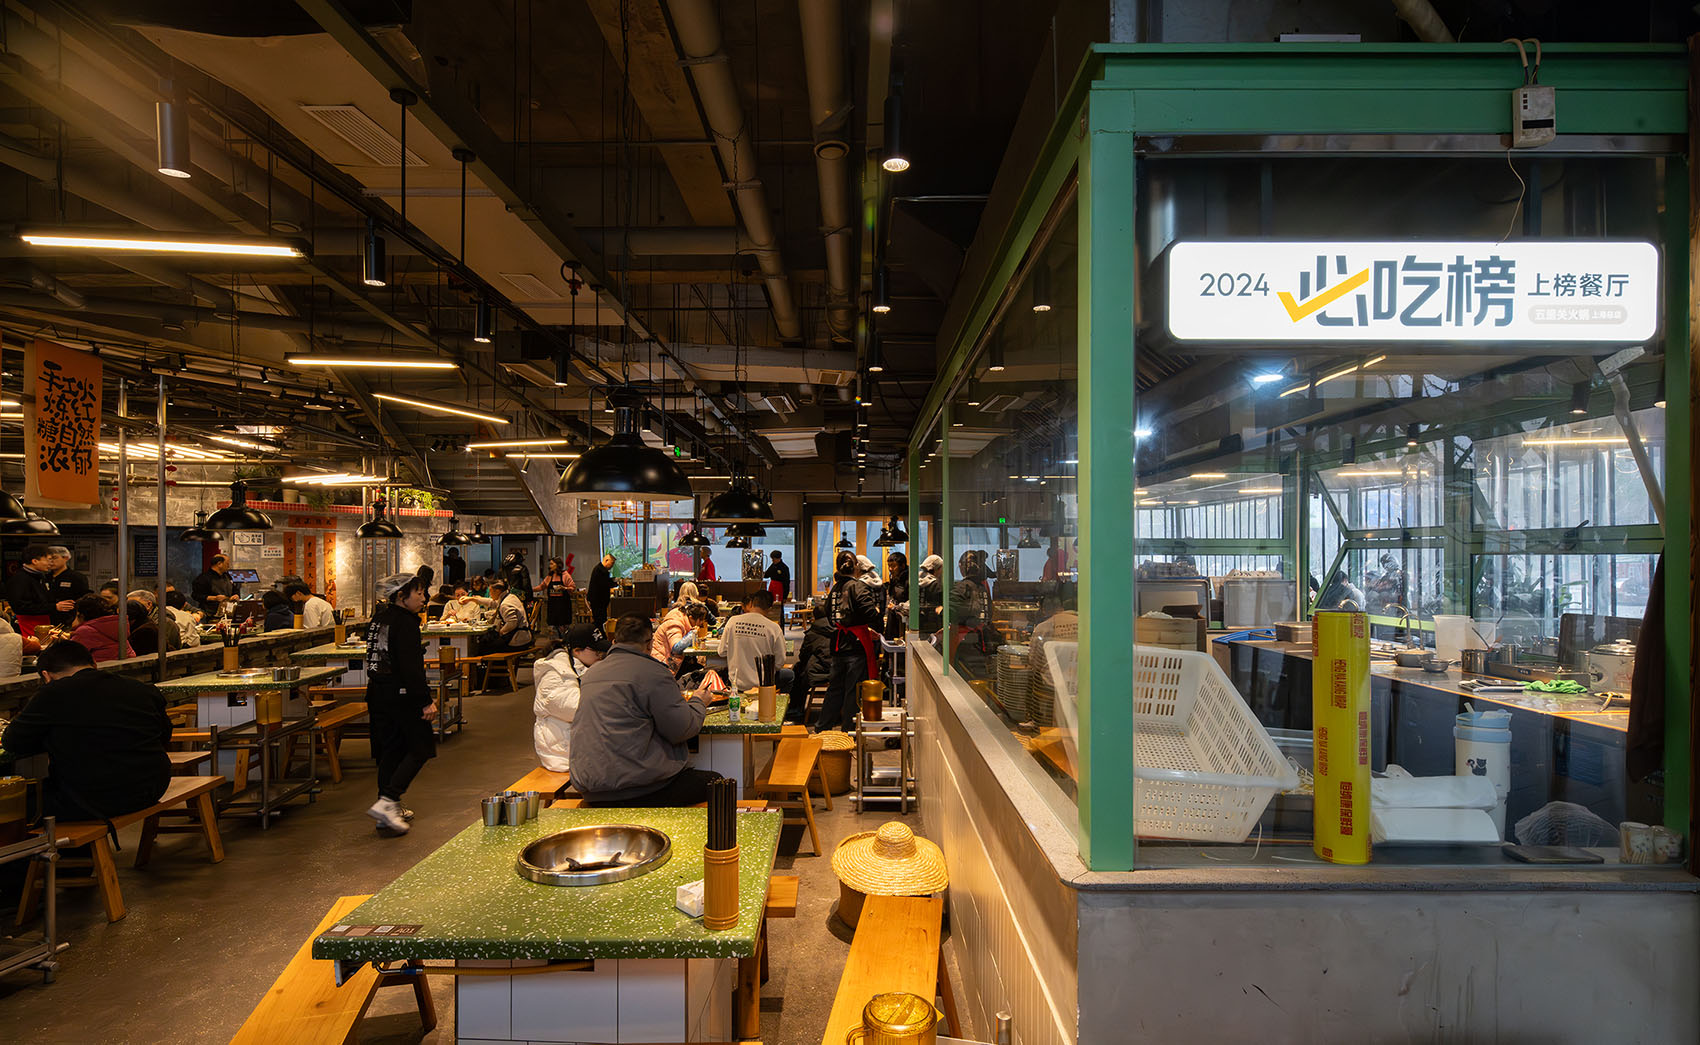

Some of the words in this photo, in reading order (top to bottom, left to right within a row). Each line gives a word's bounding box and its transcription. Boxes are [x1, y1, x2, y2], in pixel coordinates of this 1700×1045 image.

[1200, 273, 1270, 297] 2024
[1277, 255, 1516, 327] 必吃榜
[1528, 272, 1630, 297] 上榜餐厅
